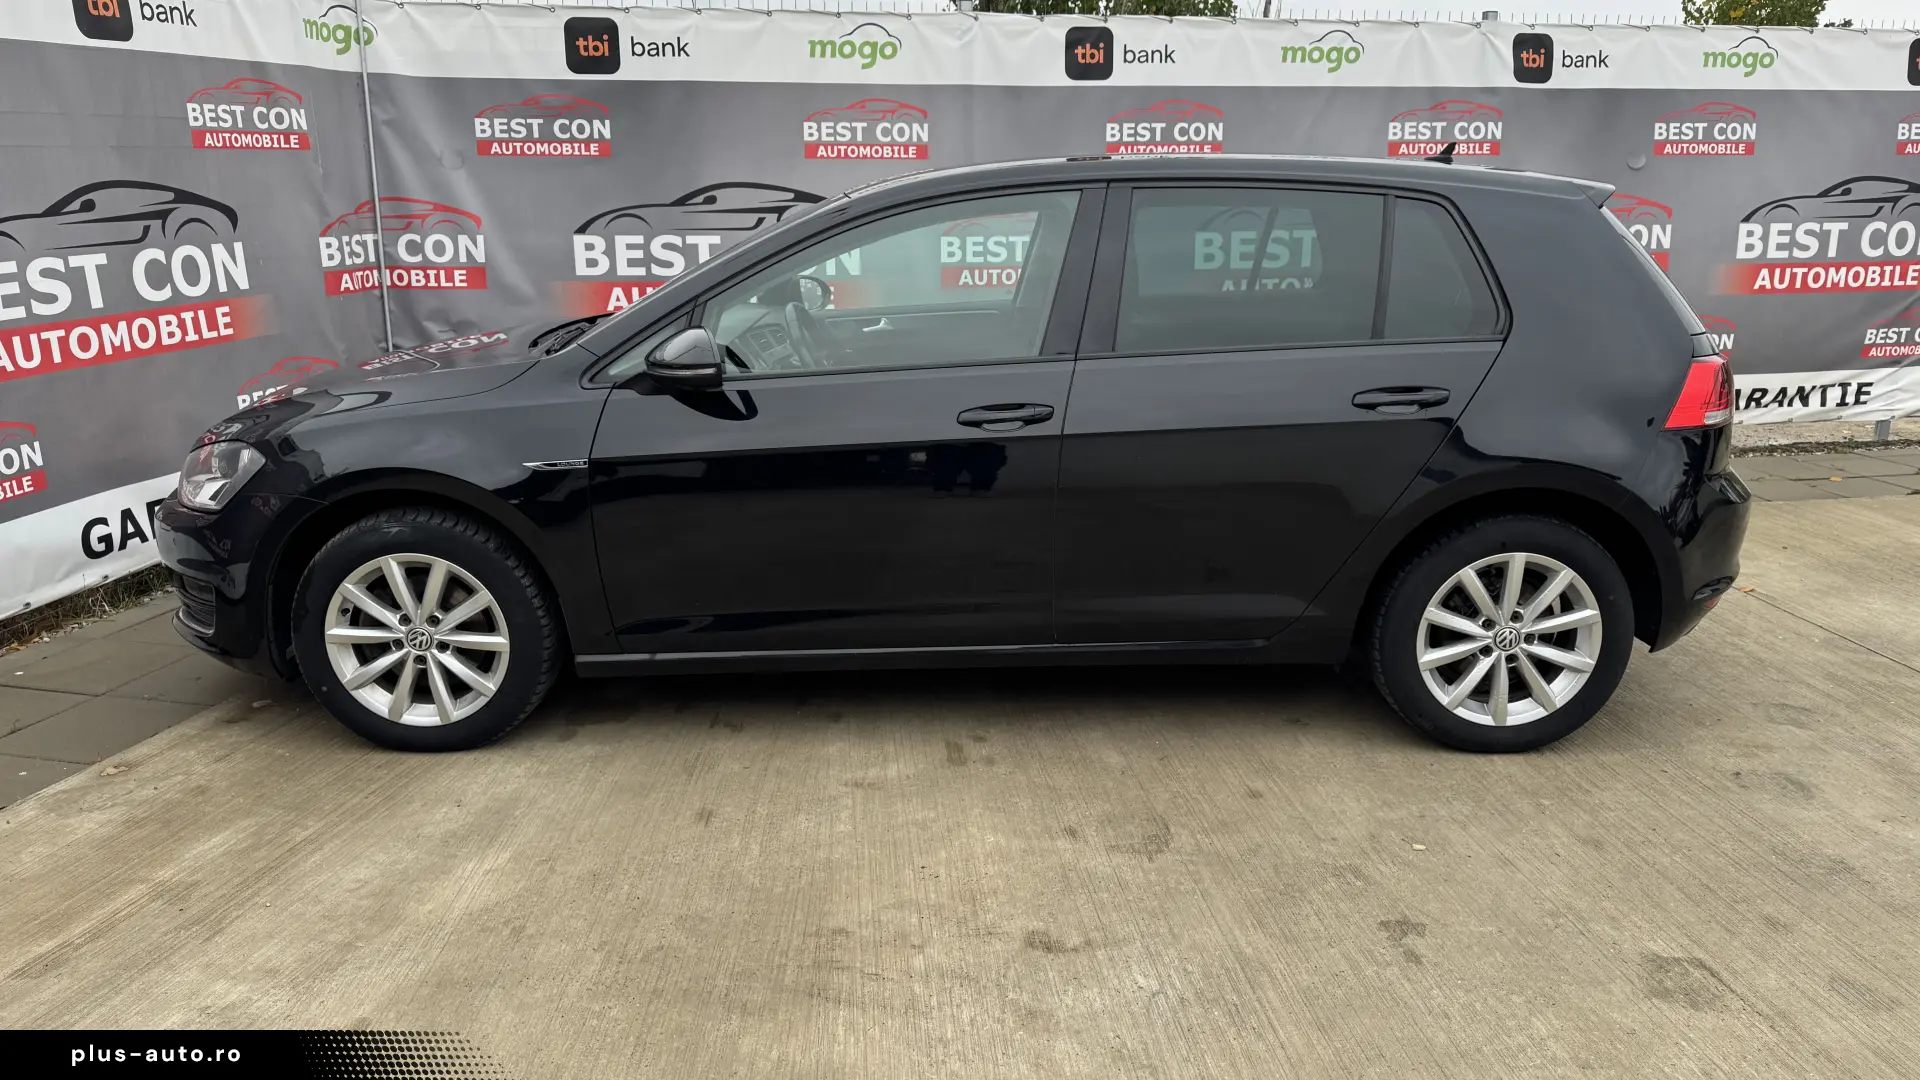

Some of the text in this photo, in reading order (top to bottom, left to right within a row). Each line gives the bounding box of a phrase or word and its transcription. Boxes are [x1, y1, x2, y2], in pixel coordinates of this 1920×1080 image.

[138, 0, 198, 27] bank
[303, 18, 374, 56] mogo
[576, 34, 690, 57] tbi bank
[809, 38, 898, 70] mogo
[1075, 43, 1176, 64] tbi bank
[1281, 44, 1361, 73] mogo
[1521, 48, 1609, 69] tbi bank
[1703, 49, 1775, 77] mogo
[186, 103, 308, 131] BEST CON
[475, 118, 611, 139] BEST CON
[803, 122, 929, 142] BEST CON
[1106, 122, 1223, 142] BEST CON
[1388, 121, 1502, 140] BEST CON
[1654, 122, 1757, 140] BEST CON
[1897, 123, 1920, 140] BE
[204, 132, 300, 148] AUTOMOBILE
[490, 142, 599, 155] AUTOMOBILE
[1664, 143, 1746, 154] AUTOMOBILE
[817, 146, 917, 158] AUTOMOBILE
[319, 233, 486, 267] BEST CON
[940, 235, 1031, 263] BEST
[1194, 229, 1317, 270] BEST
[1736, 220, 1920, 259] BEST CO
[573, 234, 721, 277] BEST
[132, 241, 250, 302] CON
[958, 268, 1021, 286] AUTO
[1753, 265, 1920, 289] AUTOMOBILE
[1864, 327, 1911, 344] BEST
